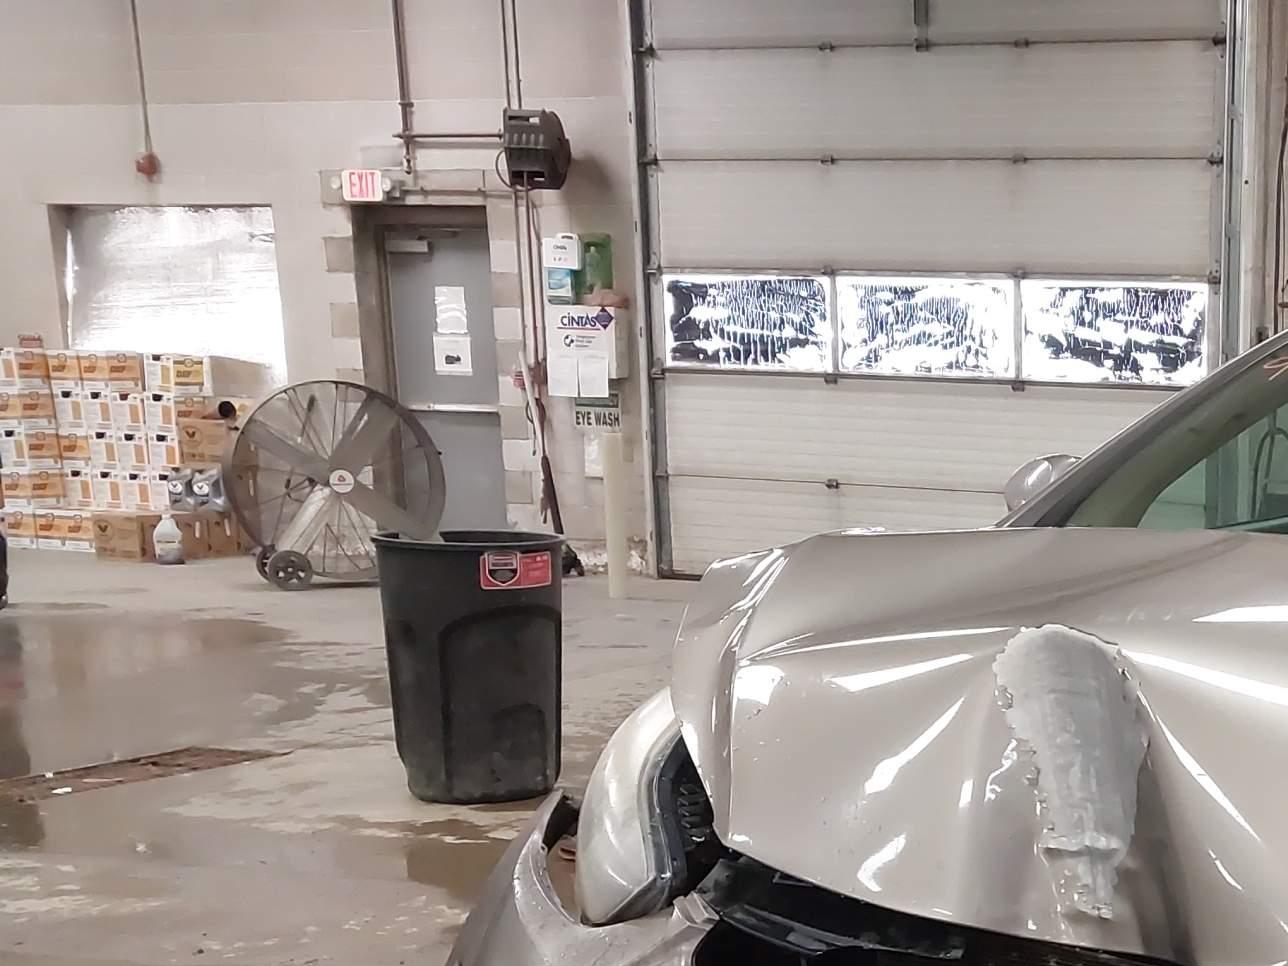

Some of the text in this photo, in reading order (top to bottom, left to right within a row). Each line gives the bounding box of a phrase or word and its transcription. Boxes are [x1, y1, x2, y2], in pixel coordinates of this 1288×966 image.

[349, 172, 375, 199] EXIT
[575, 410, 621, 428] EYE WASH
